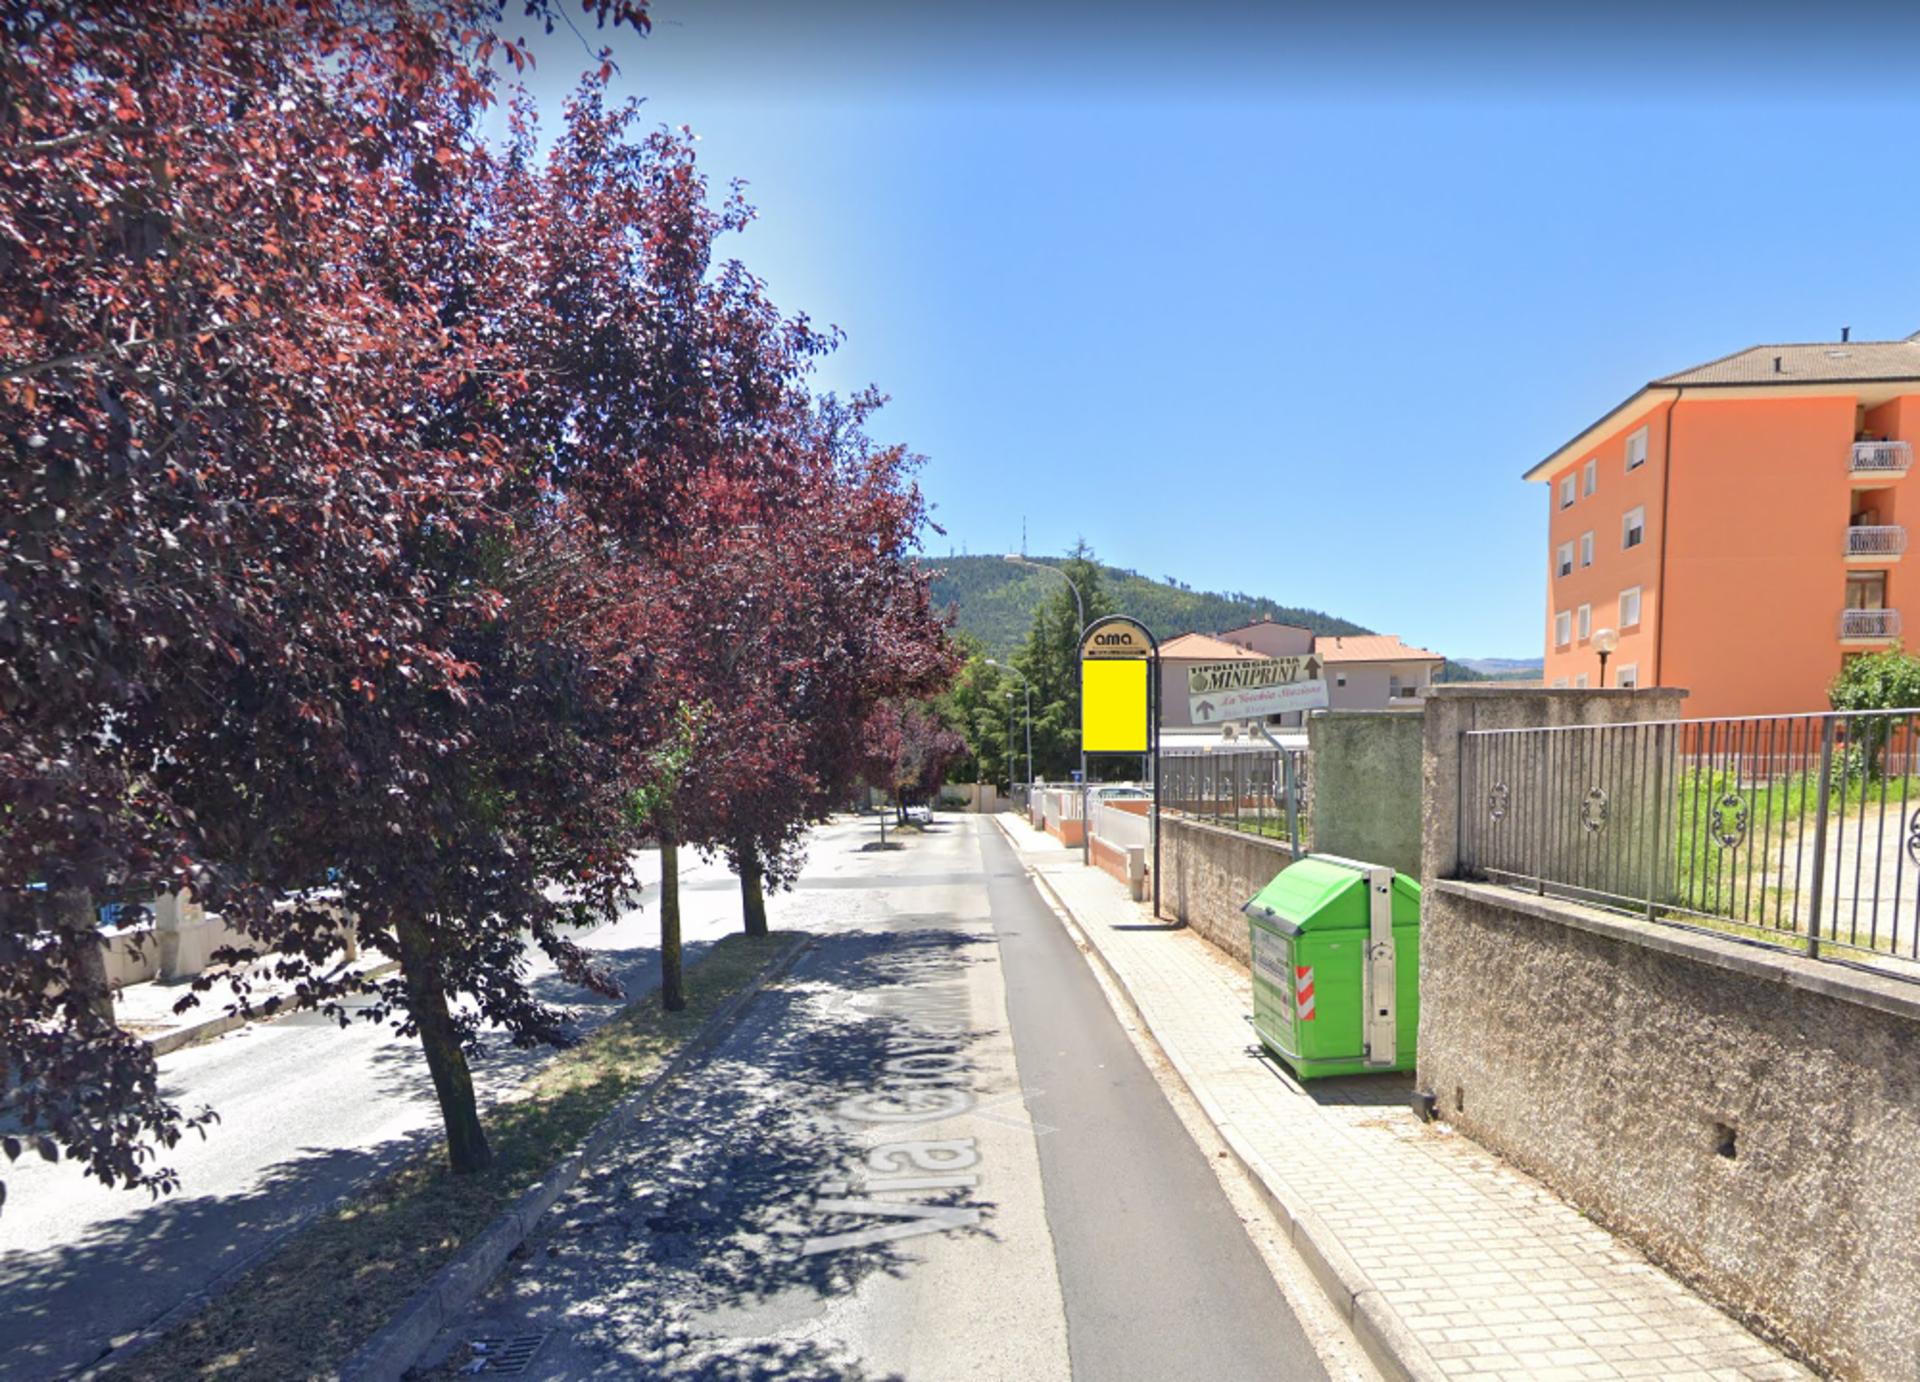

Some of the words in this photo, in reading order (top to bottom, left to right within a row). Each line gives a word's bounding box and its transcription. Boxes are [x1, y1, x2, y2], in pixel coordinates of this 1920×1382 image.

[1094, 633, 1132, 646] ama
[1190, 657, 1300, 674] TIPOLITOGRAFIA
[1208, 664, 1299, 689] MINIPRINT
